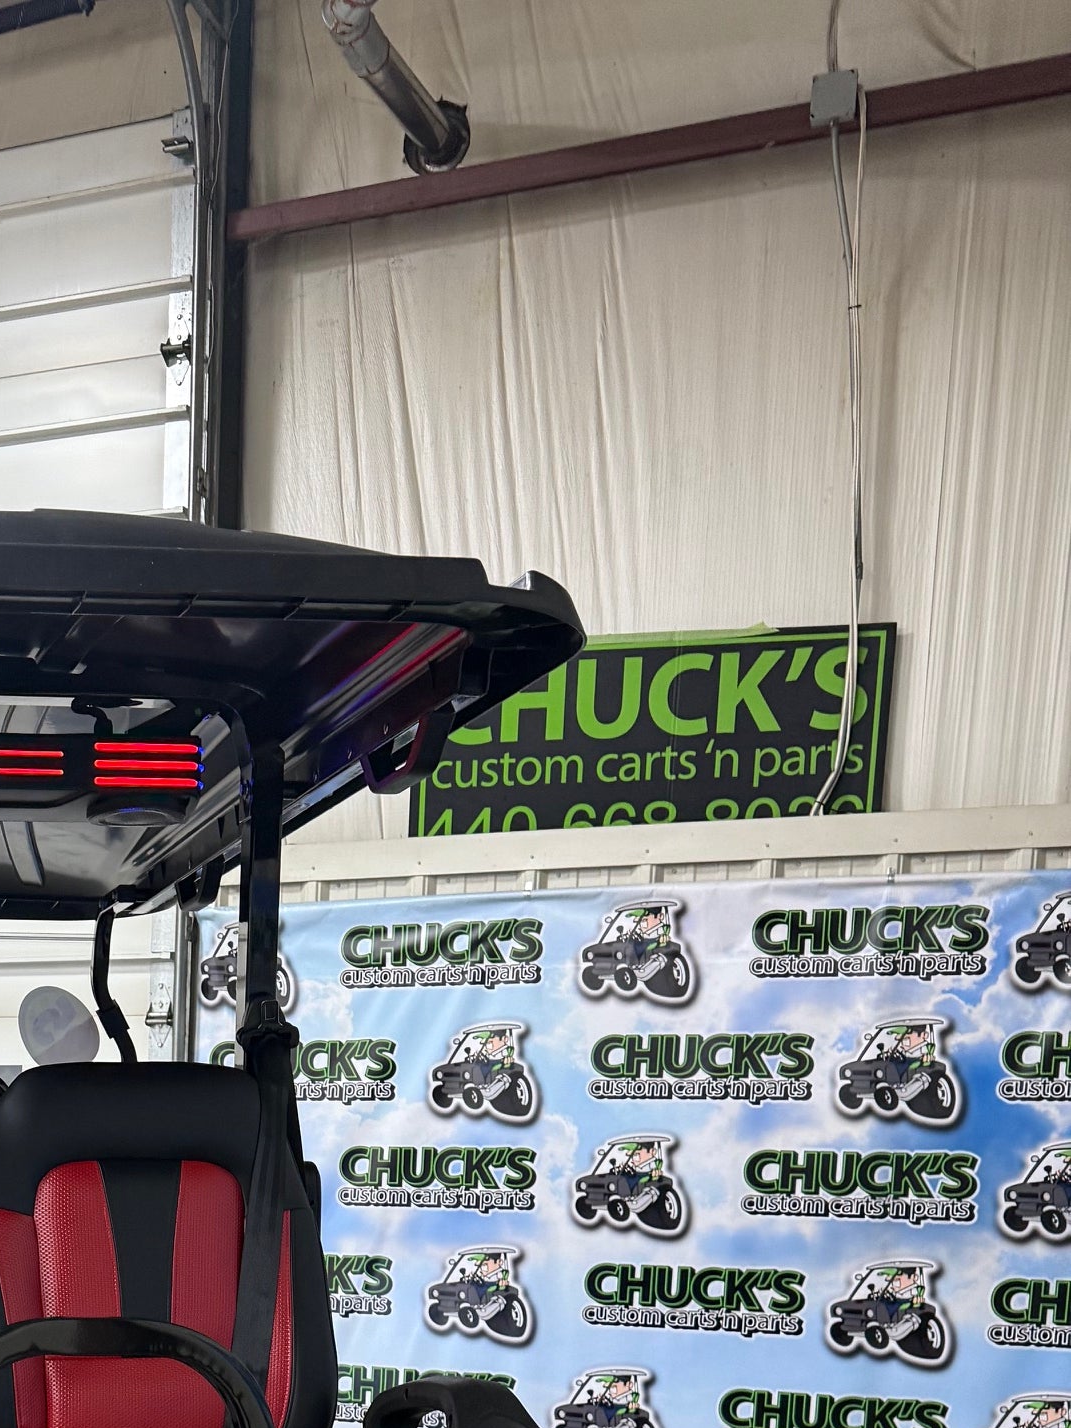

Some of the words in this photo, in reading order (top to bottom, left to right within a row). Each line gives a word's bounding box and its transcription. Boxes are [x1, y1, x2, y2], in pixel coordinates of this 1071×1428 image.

[431, 751, 585, 789] custom
[596, 745, 697, 782] carts
[753, 739, 864, 788] parts
[341, 918, 543, 967] CHUCK'S
[752, 905, 990, 955] CHUCK'S
[340, 967, 414, 988] custom
[415, 965, 461, 985] carts
[484, 962, 540, 988] parts
[750, 956, 837, 977] custom
[838, 954, 893, 975] carts
[920, 953, 985, 980] parts
[591, 1033, 814, 1079] CHUCK'S
[342, 1081, 396, 1105] parts
[589, 1078, 671, 1099] custom
[672, 1078, 725, 1098] carts
[749, 1079, 811, 1105] parts
[339, 1146, 537, 1190] CHUCK'S
[743, 1149, 979, 1199] CHUCK'S
[339, 1186, 411, 1207] custom
[411, 1188, 457, 1207] carts
[479, 1189, 535, 1213] parts
[741, 1195, 828, 1217] custom
[829, 1196, 883, 1218] carts
[909, 1199, 976, 1225] parts
[585, 1263, 806, 1313] CHUCK'S
[340, 1295, 392, 1317] parts
[583, 1305, 666, 1328] custom
[666, 1309, 717, 1330] carts
[742, 1313, 802, 1337] parts
